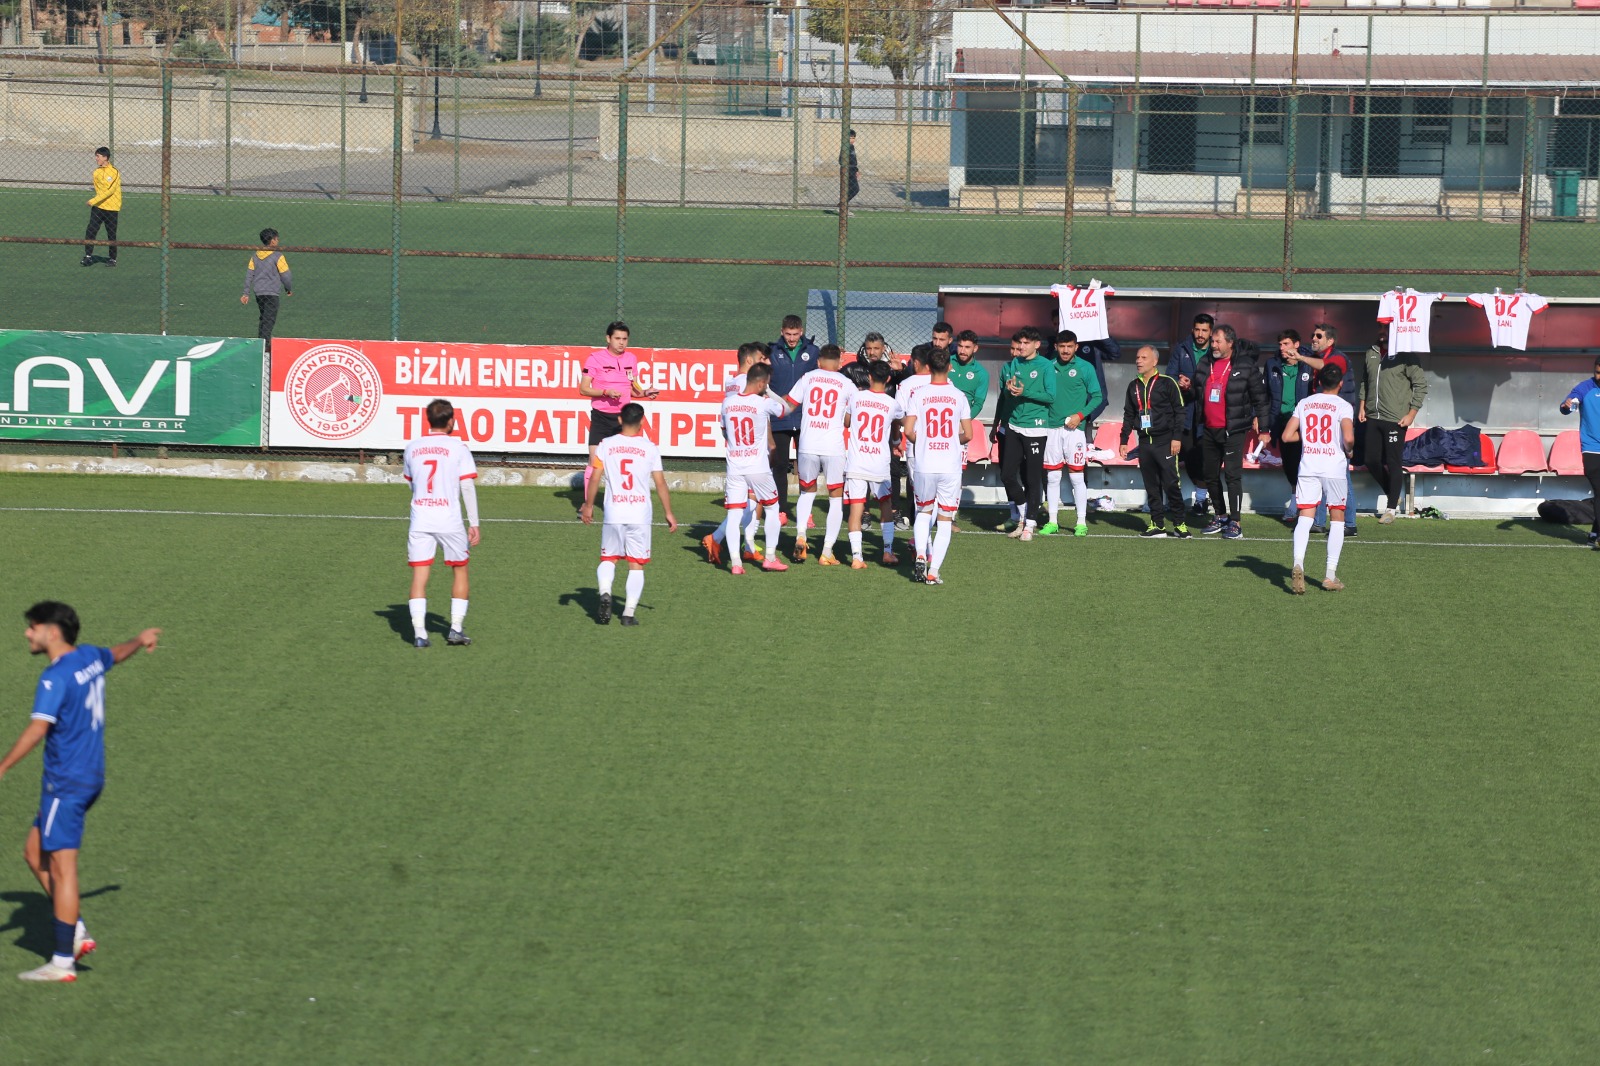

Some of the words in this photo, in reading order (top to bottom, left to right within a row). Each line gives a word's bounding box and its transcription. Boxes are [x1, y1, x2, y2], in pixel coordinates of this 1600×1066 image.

[1396, 295, 1417, 322] 12
[395, 348, 471, 386] BİZİM
[295, 360, 318, 416] BATMAN
[318, 354, 372, 417] PETROLSPOR
[807, 386, 839, 419] 99
[142, 421, 183, 429] BAK
[316, 421, 349, 432] 1960
[730, 416, 755, 446] 10
[857, 411, 884, 443] 20
[926, 407, 953, 438] 66
[1305, 413, 1332, 444] 88
[928, 442, 949, 450] SEZER
[1031, 447, 1040, 455] 14
[1074, 452, 1084, 464] 62
[423, 459, 438, 493] 7
[620, 459, 633, 490] 5
